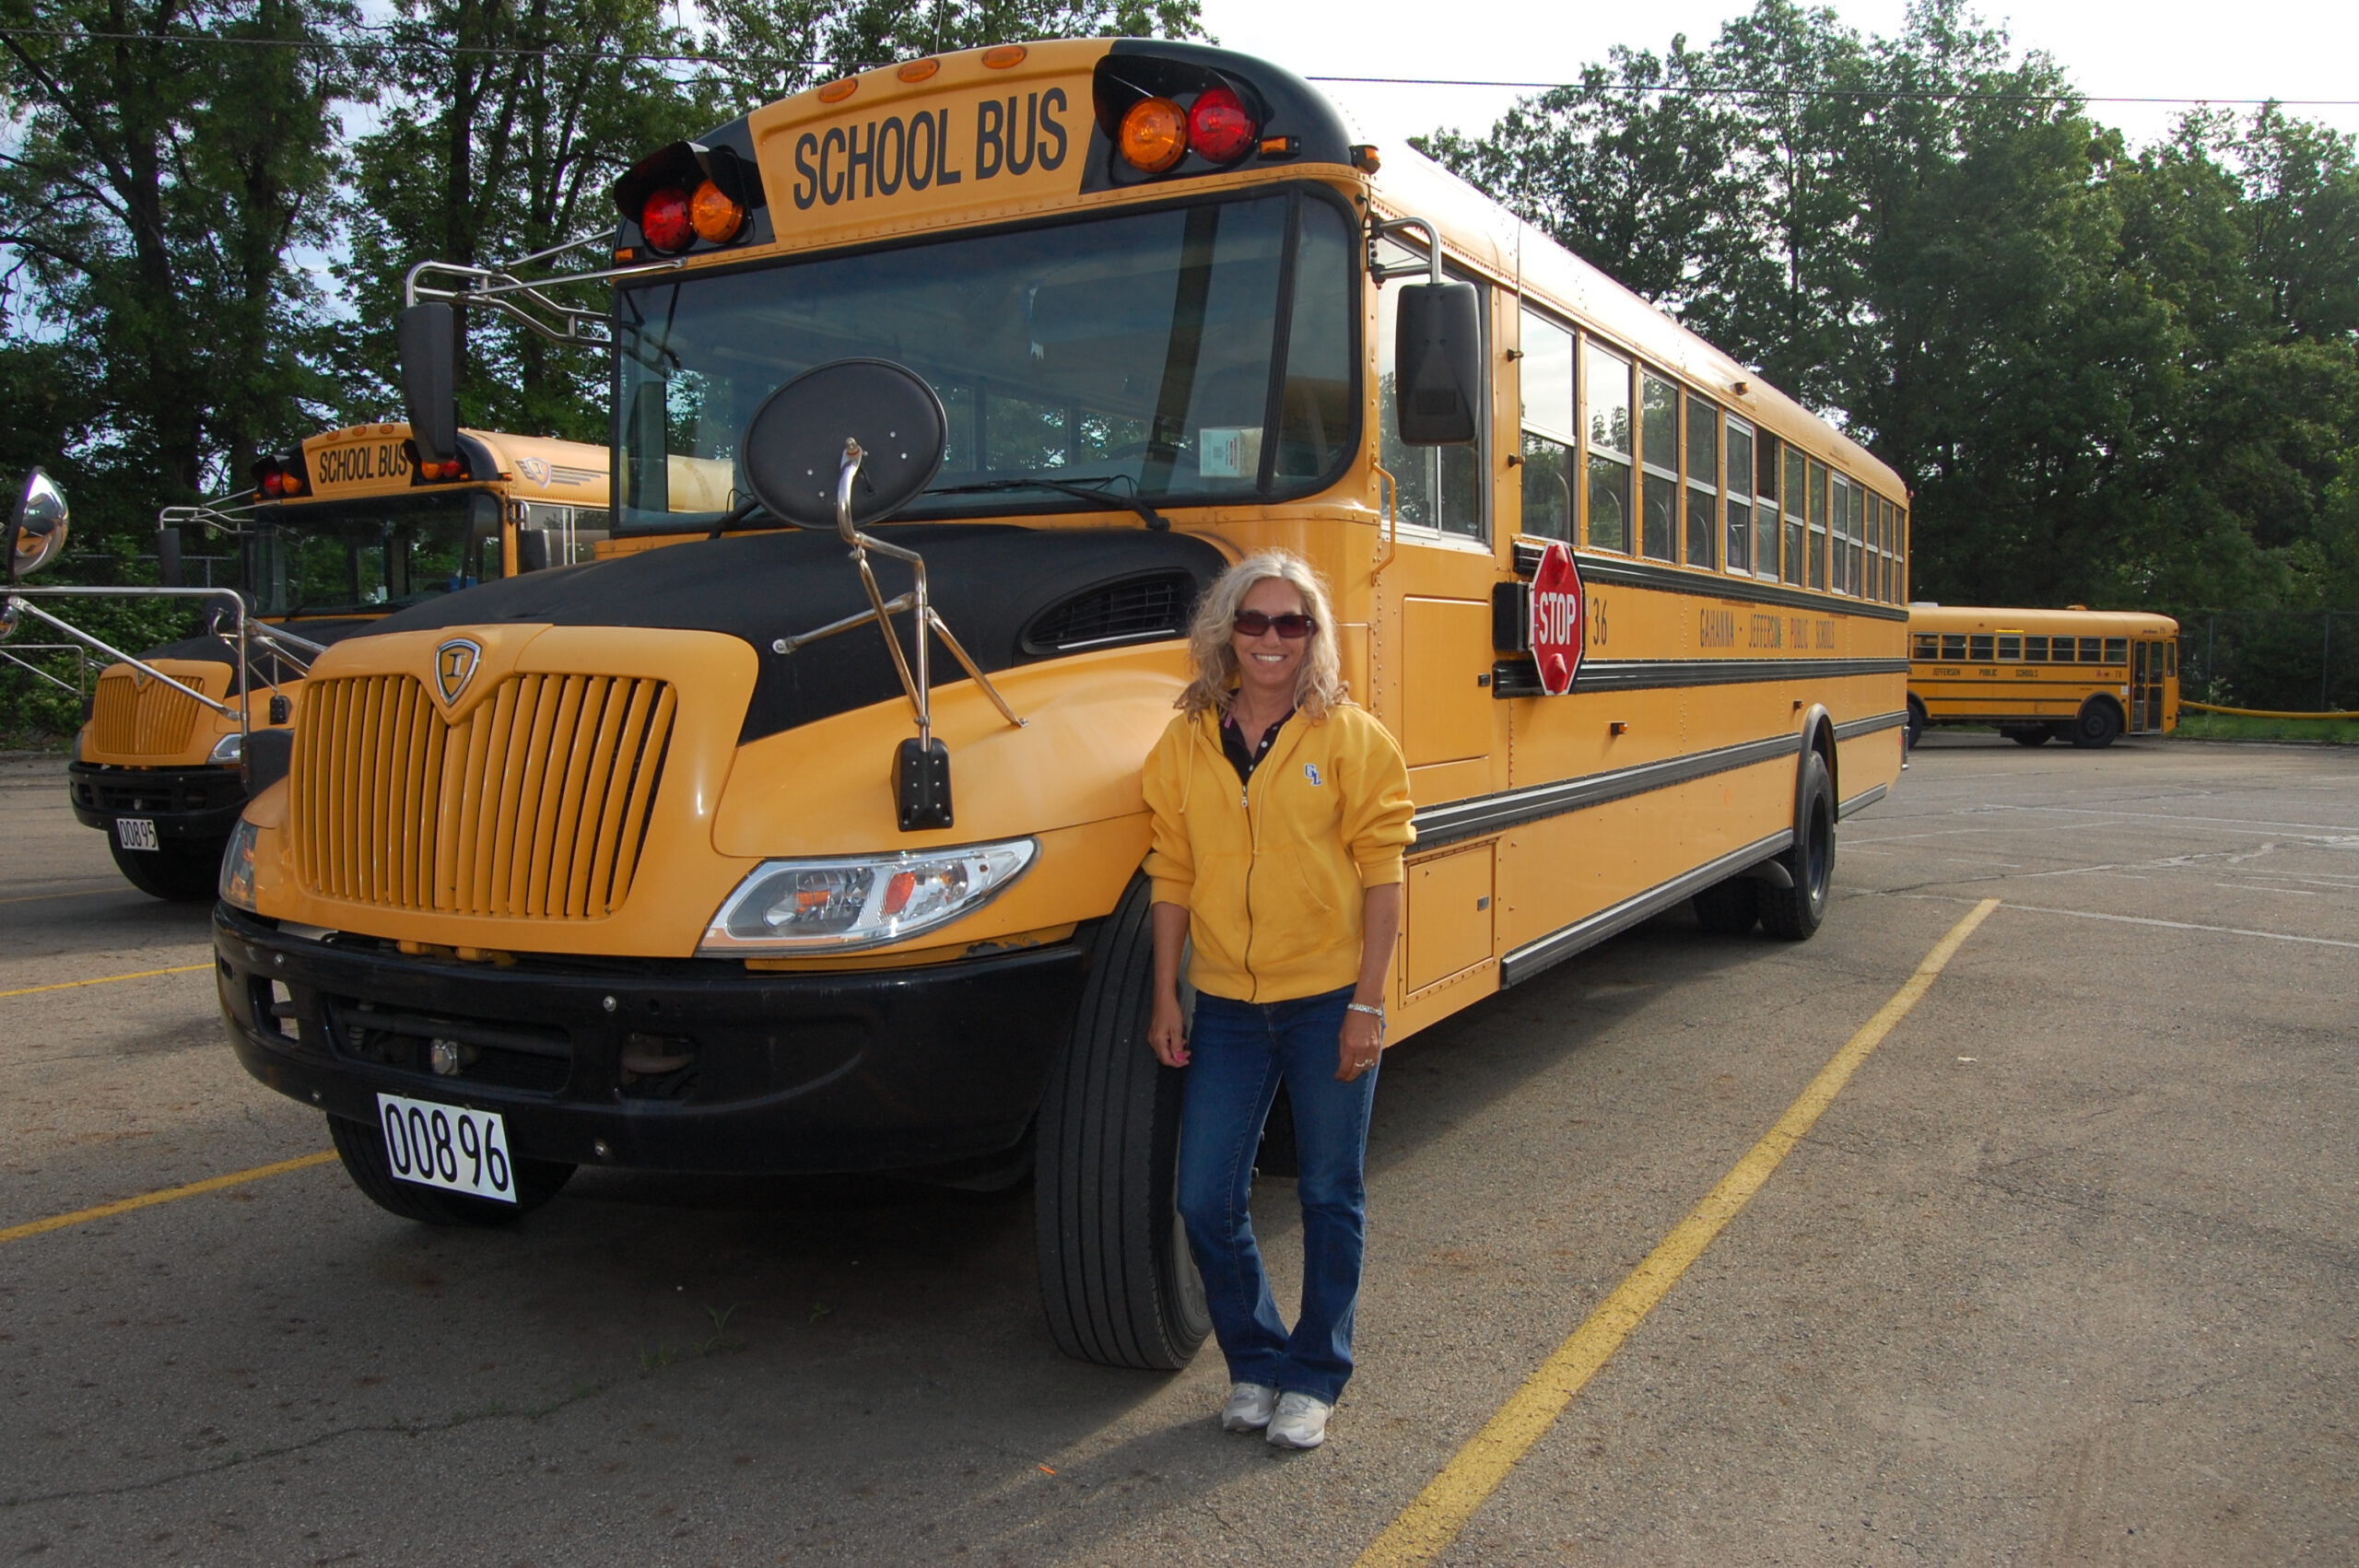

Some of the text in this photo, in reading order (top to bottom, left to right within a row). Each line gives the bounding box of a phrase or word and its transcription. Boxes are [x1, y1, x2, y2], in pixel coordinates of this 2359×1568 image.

[793, 87, 1068, 210] SCHOOL BUS
[319, 443, 408, 484] SCHOOL BUS
[1539, 591, 1576, 645] STOP
[1593, 597, 1607, 646] 36
[1700, 608, 1734, 647] GAHANNA
[1748, 614, 1781, 649] JEFFERSON
[1790, 617, 1808, 649] PUBLIC
[1816, 620, 1835, 649] SCHOOLS
[1978, 668, 1998, 677] PUBLIC
[2015, 669, 2039, 678] SCHOOLS
[119, 820, 157, 848] 00895
[385, 1103, 509, 1192] 00896
